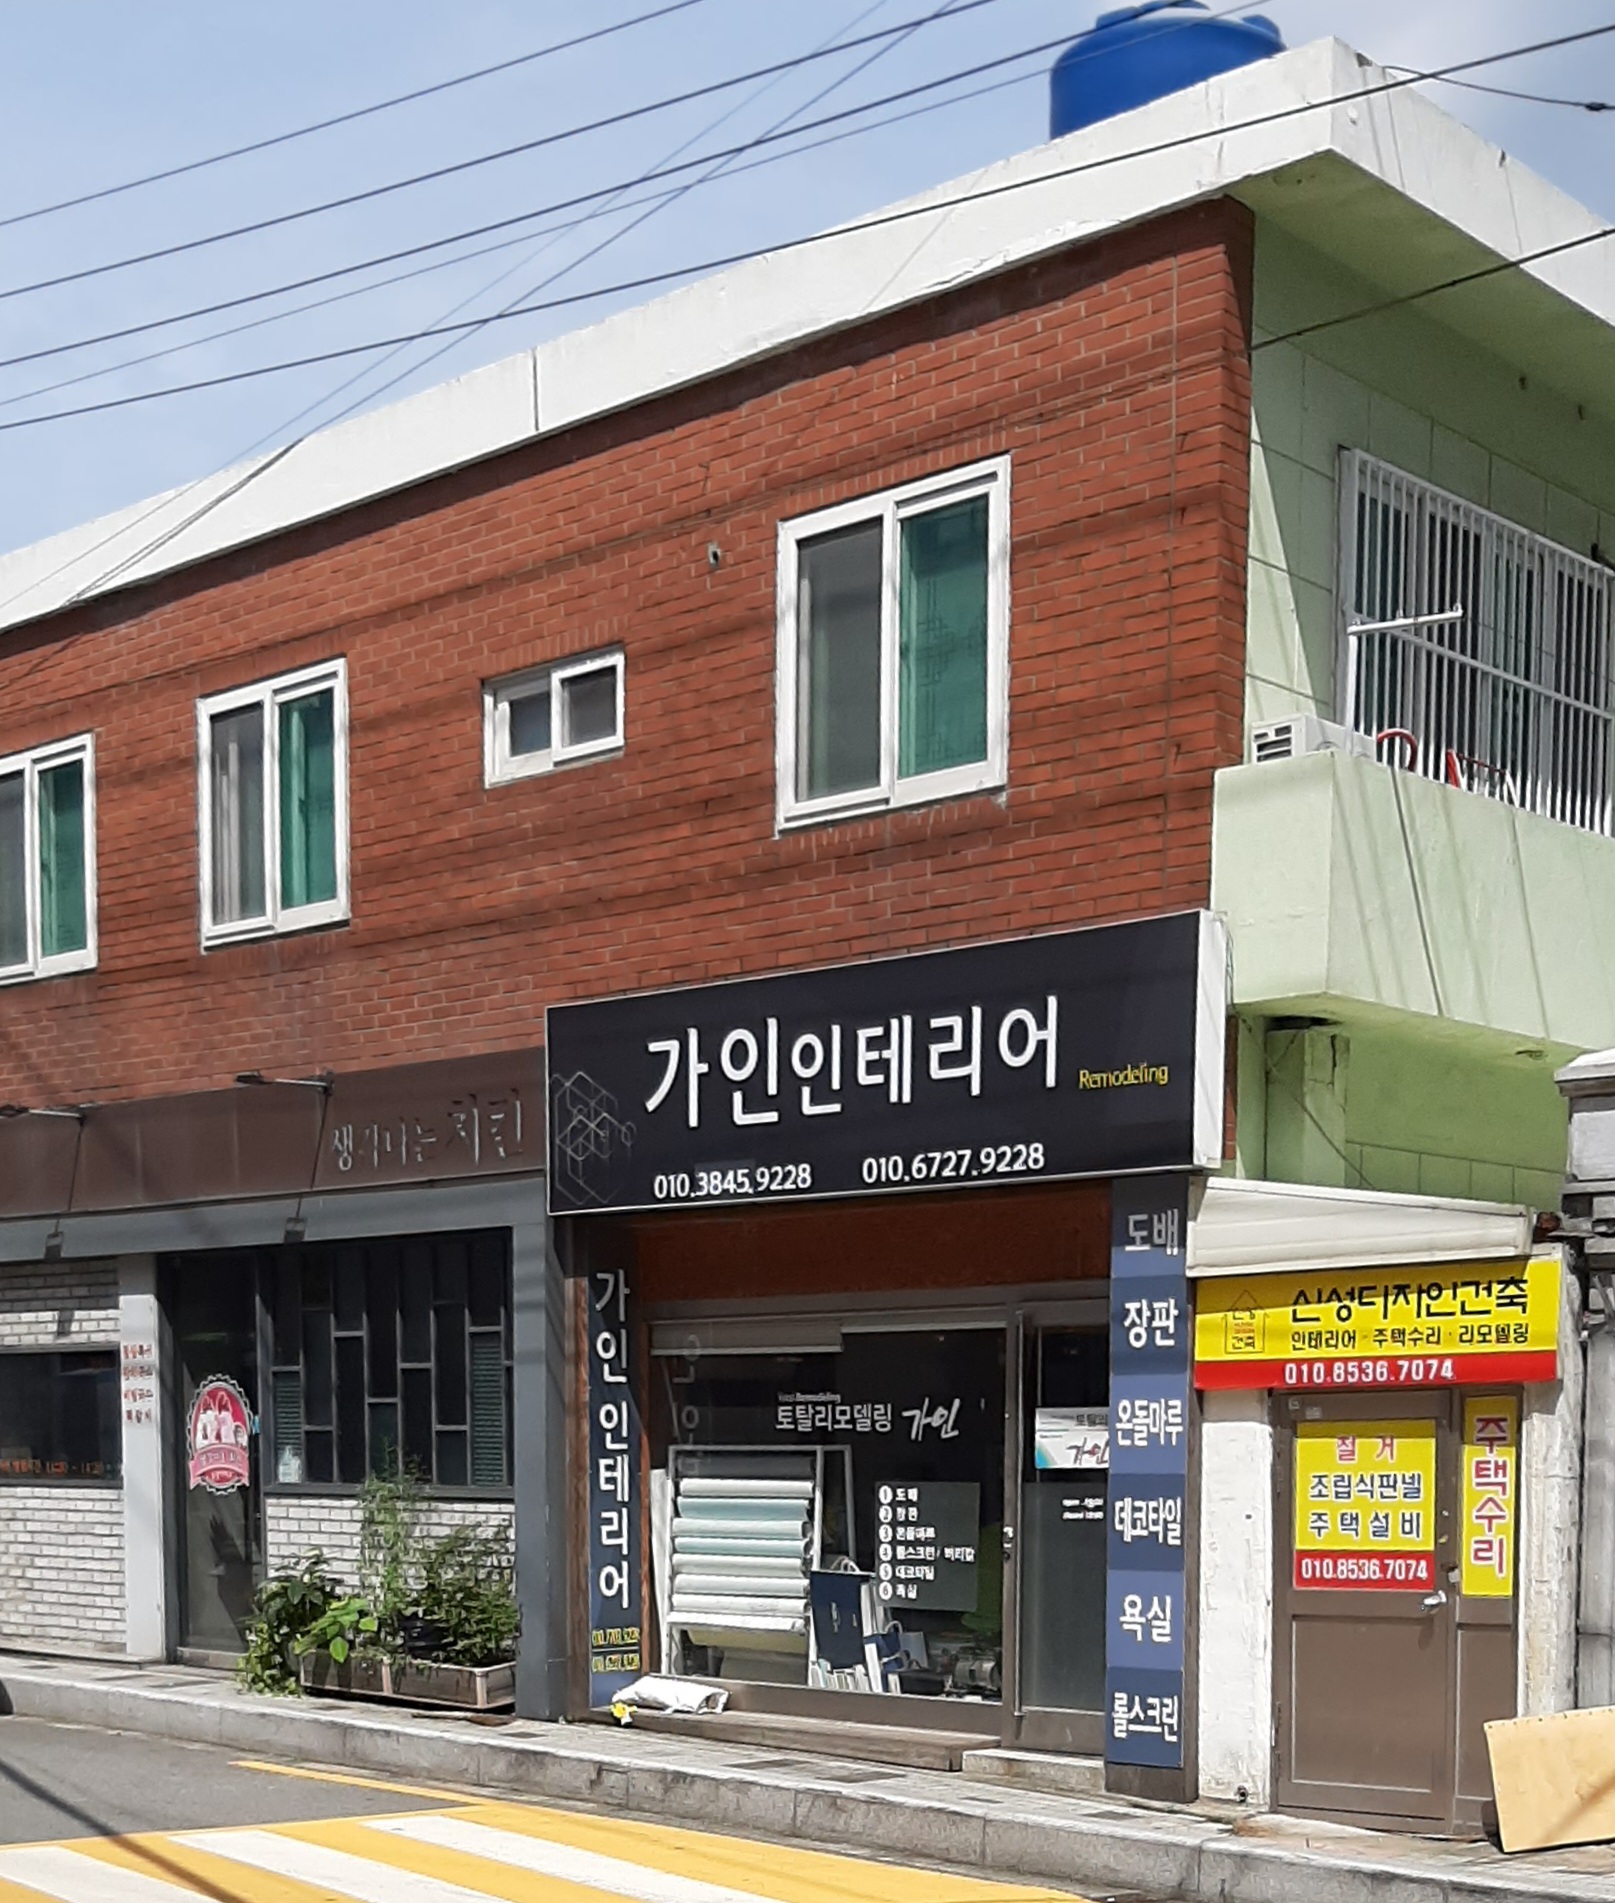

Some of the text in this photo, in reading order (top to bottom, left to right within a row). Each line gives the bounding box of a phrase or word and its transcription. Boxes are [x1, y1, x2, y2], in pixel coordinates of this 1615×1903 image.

[645, 995, 1058, 1128] 가인인테리어
[1078, 1062, 1169, 1090] Remodeling
[653, 1163, 812, 1200] 010.3845.9228
[861, 1142, 1045, 1184] 010.6727.9228
[1124, 1208, 1178, 1256] 도배
[1291, 1276, 1529, 1323] 신성디자인건축
[1124, 1298, 1178, 1348] 장판
[1291, 1328, 1357, 1351] 인테리어
[1372, 1325, 1442, 1347] 주택수리
[1284, 1358, 1454, 1385] 010.8536.7074
[775, 1397, 960, 1442] 토탈리모델링 가인
[1115, 1398, 1184, 1447] 온돌마루
[1309, 1472, 1422, 1500] 조립식판넬
[1472, 1417, 1509, 1576] 주택수리
[1114, 1497, 1182, 1545] 데코타일
[1309, 1511, 1421, 1539] 주택설비
[1301, 1558, 1428, 1580] 010.8536.7074
[1119, 1594, 1172, 1643] 욕실
[1112, 1692, 1178, 1742] 롤스크린
